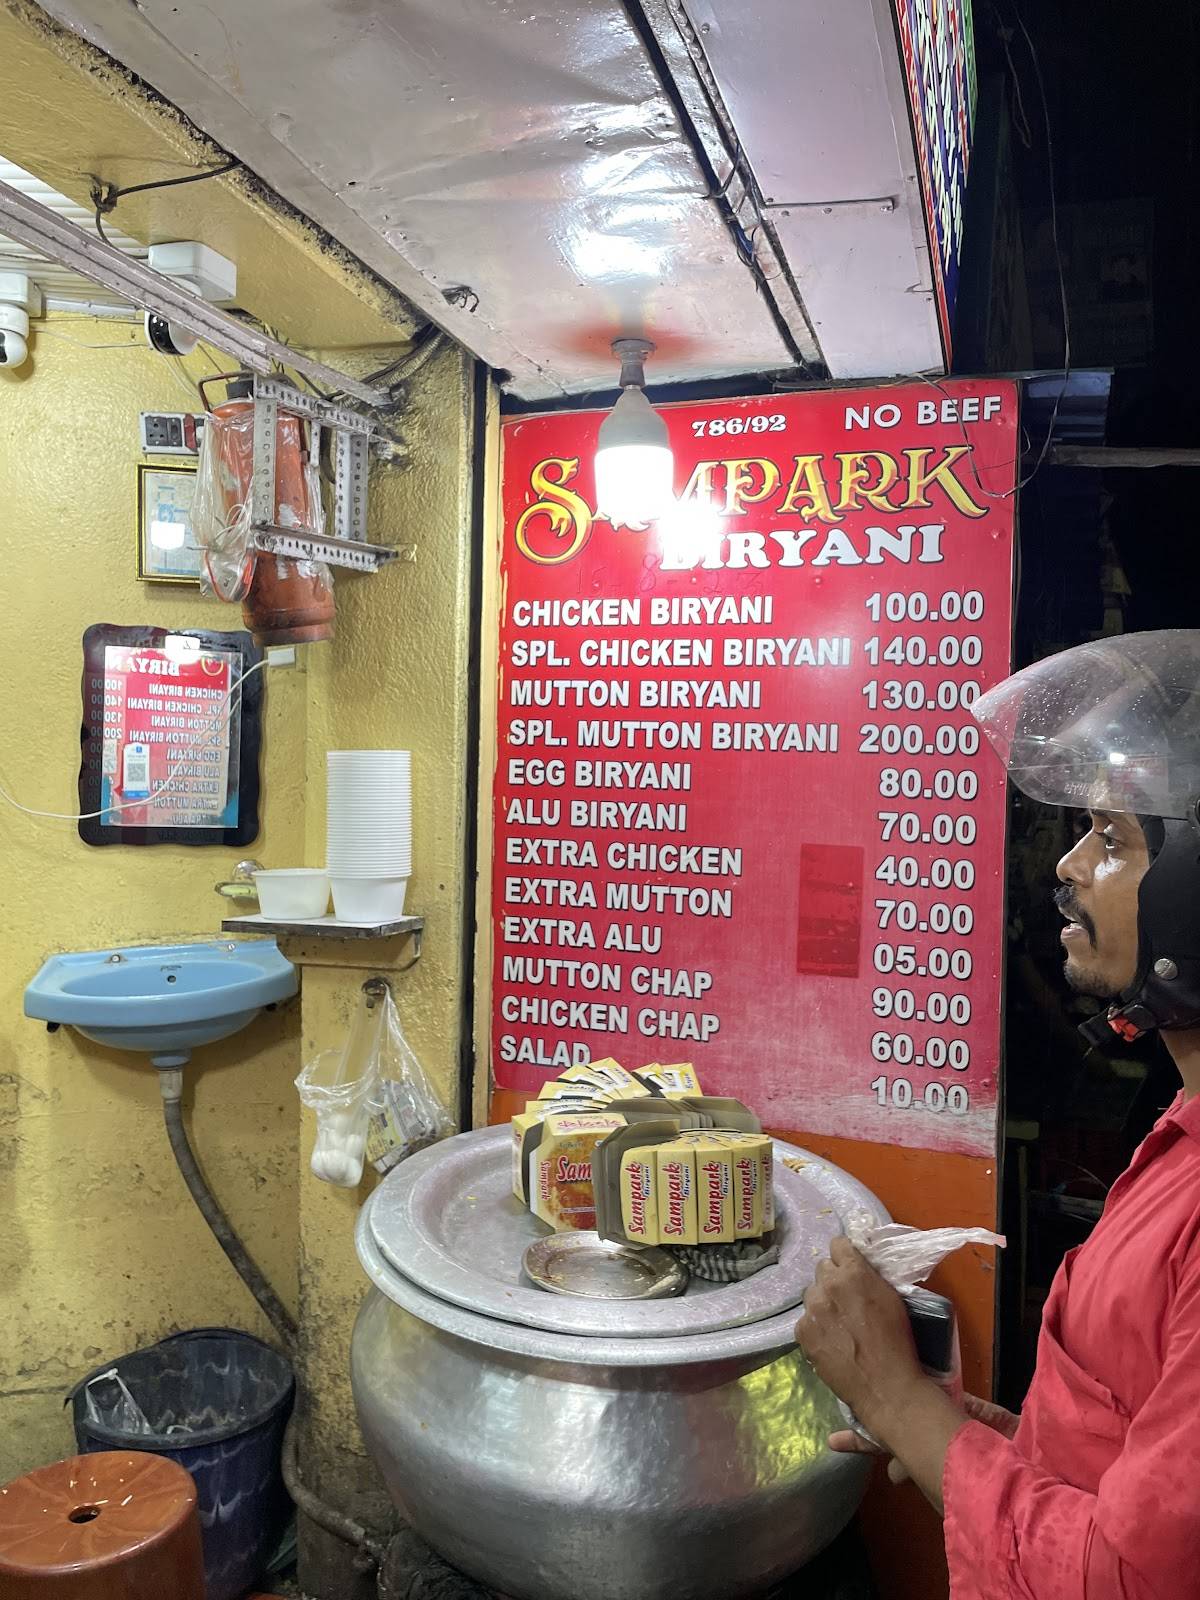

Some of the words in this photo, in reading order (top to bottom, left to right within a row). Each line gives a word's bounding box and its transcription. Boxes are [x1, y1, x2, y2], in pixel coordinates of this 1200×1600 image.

[692, 415, 787, 437] 786/92
[845, 404, 901, 429] NO
[917, 396, 1001, 426] BEEF
[512, 597, 640, 627] CHICKEN
[651, 596, 772, 625] BIRYANI
[866, 591, 984, 622] 100.00
[511, 640, 569, 667] SPL.
[579, 640, 712, 667] CHICKEN
[723, 637, 850, 666] BIRYANI
[864, 636, 982, 666] 140.00
[510, 681, 629, 707] MUTTON
[640, 681, 760, 708] BIRYANI
[862, 681, 982, 711] 130.00
[509, 721, 568, 746] SPL.
[577, 721, 701, 750] MUTTON
[712, 724, 839, 753] BIRYANI
[859, 725, 979, 755] 200.00
[508, 759, 565, 787] EGG
[574, 761, 691, 790] BIRYANI
[879, 768, 978, 800] 80.00
[507, 799, 560, 826] ALU
[570, 800, 687, 831] BIRYANI
[878, 812, 976, 844] 70.00
[506, 839, 598, 868] EXTRA
[606, 842, 742, 876] CHICKEN
[875, 856, 975, 889] 40.00
[505, 877, 597, 908] EXTRA
[606, 883, 732, 917] MUTTON
[875, 900, 974, 935] 70.00
[504, 917, 595, 948] EXTRA
[604, 923, 661, 953] ALU
[873, 943, 973, 979] 05.00
[503, 956, 622, 992] MUTTON
[630, 967, 712, 1000] CHAP
[872, 987, 971, 1024] 90.00
[502, 996, 628, 1033] CHICKEN
[638, 1008, 720, 1041] CHAP
[871, 1032, 970, 1070] 60.00
[500, 1036, 591, 1066] SALAD
[871, 1076, 969, 1114] 10.00
[625, 1161, 646, 1235] Sampark
[662, 1161, 685, 1236] Sampark
[702, 1160, 724, 1234] Sampark
[736, 1158, 754, 1230] Sampark
